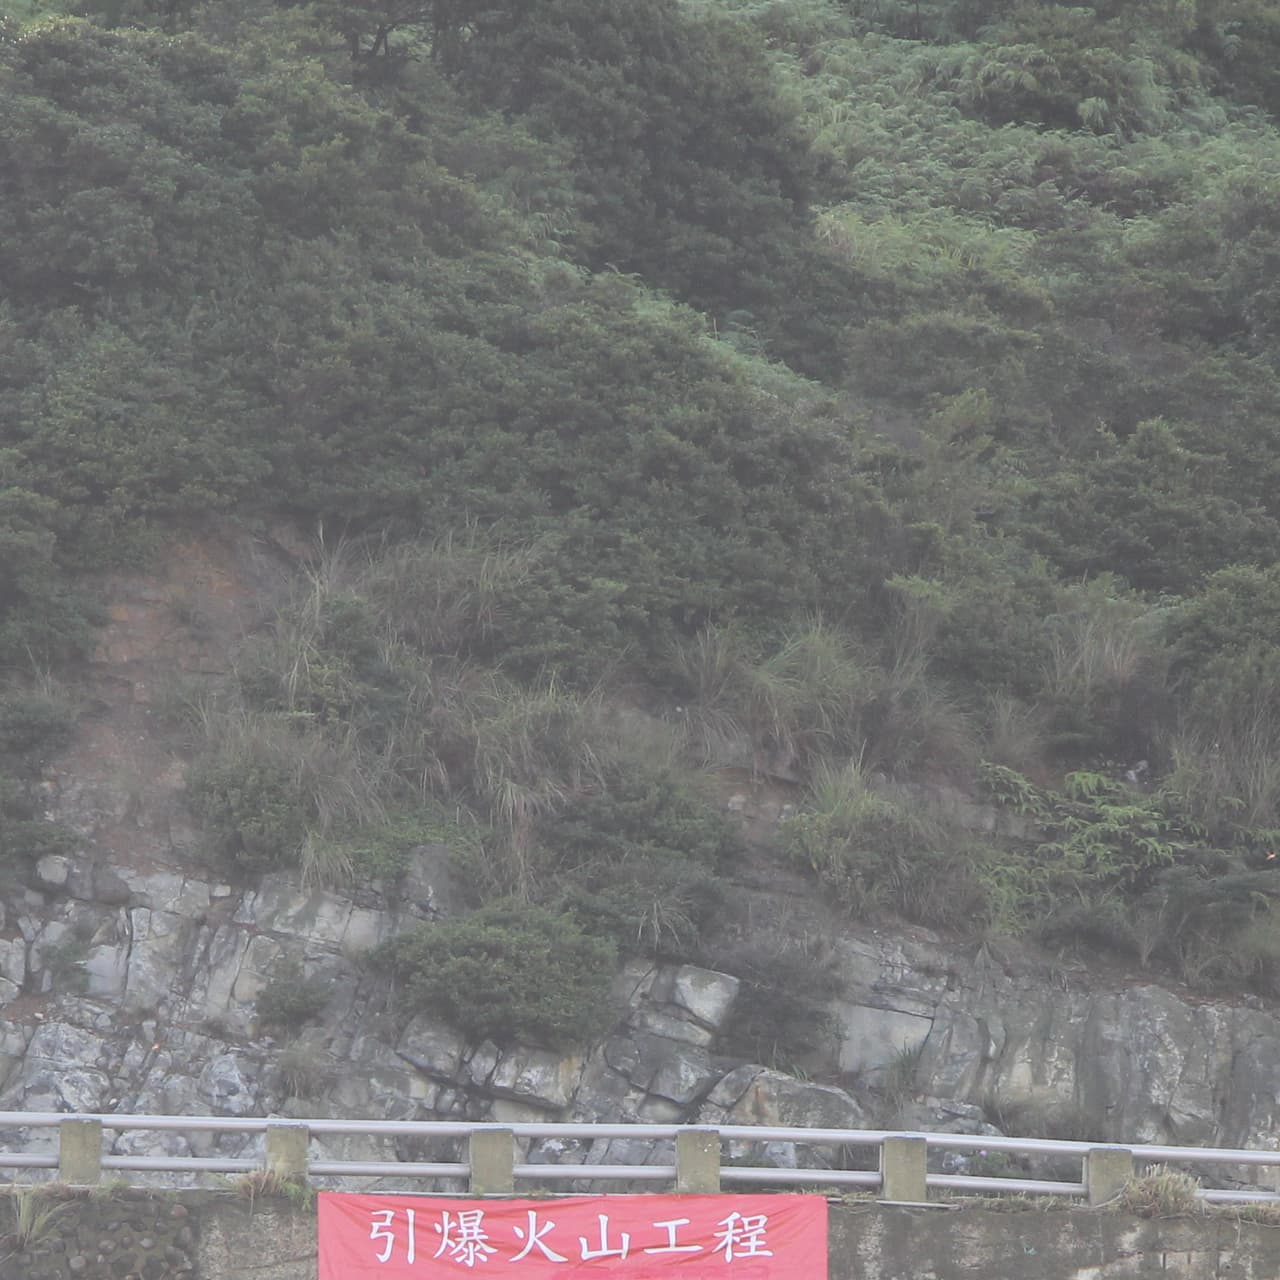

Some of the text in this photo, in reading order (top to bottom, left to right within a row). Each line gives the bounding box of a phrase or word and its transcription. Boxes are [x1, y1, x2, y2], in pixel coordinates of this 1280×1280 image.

[369, 1208, 774, 1268] 引爆火山工程
